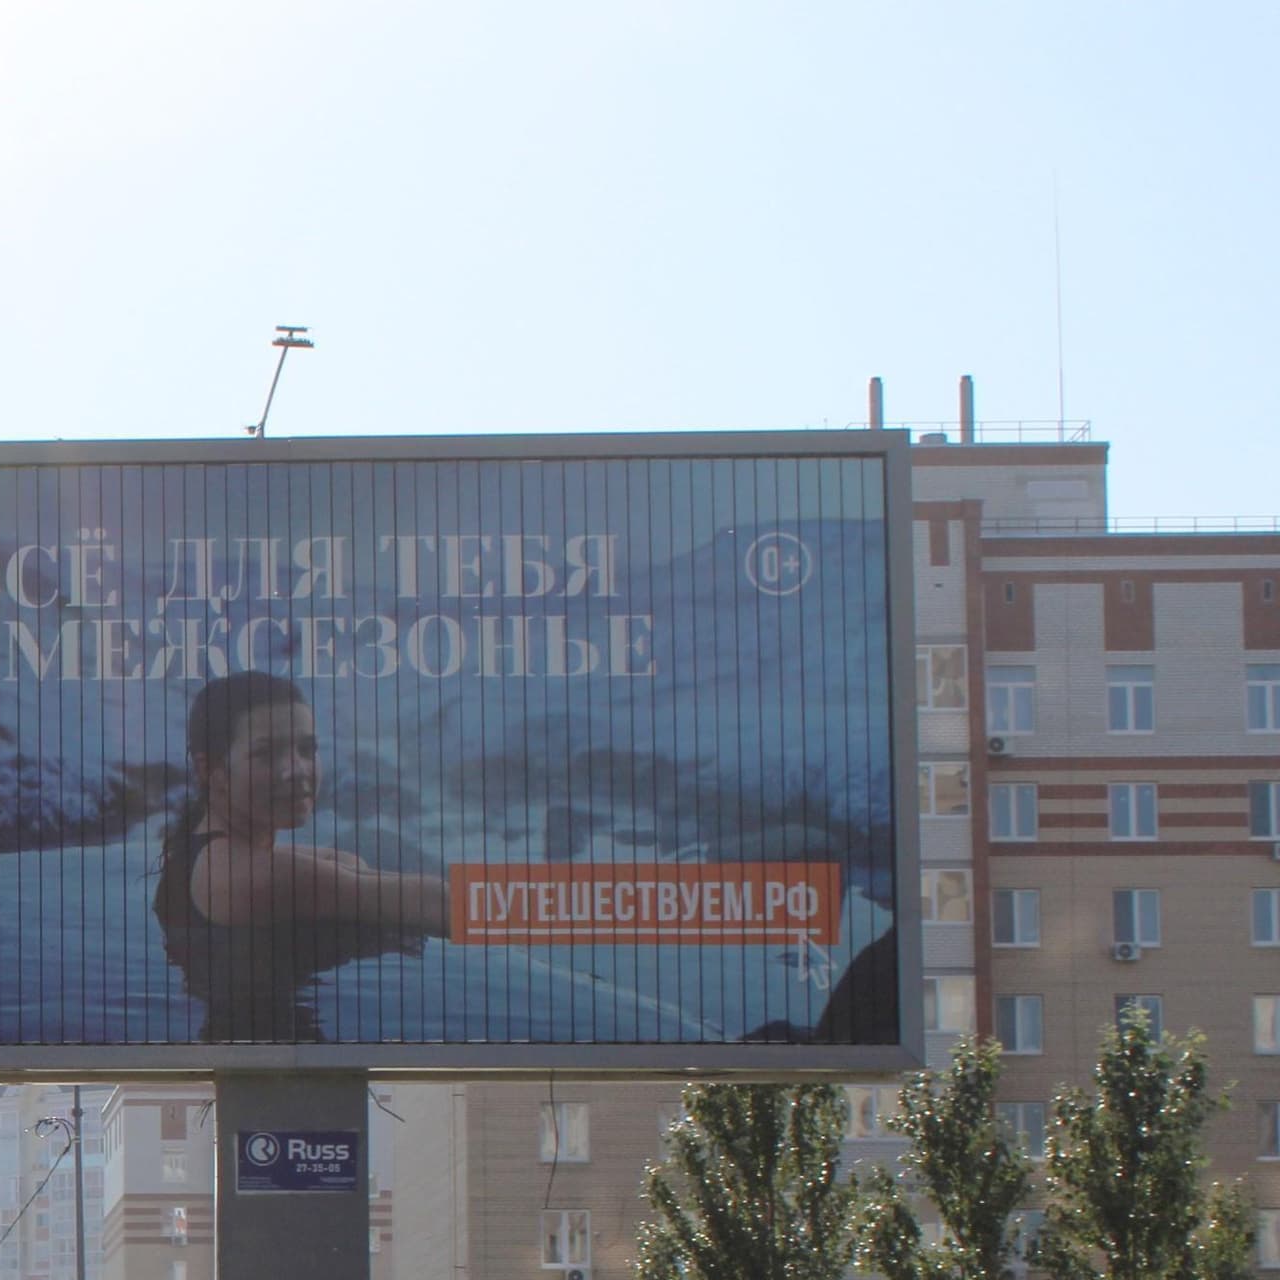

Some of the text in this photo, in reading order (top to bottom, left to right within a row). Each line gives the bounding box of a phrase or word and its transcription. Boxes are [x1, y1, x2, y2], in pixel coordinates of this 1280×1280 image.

[156, 536, 348, 616] ДЛЯ
[379, 533, 620, 599] ТЕБЯ
[2, 614, 658, 682] МЕЖСЕЗОНЬЕ
[468, 880, 820, 922] ПУТЕШЕСТВУЕМ.РФ
